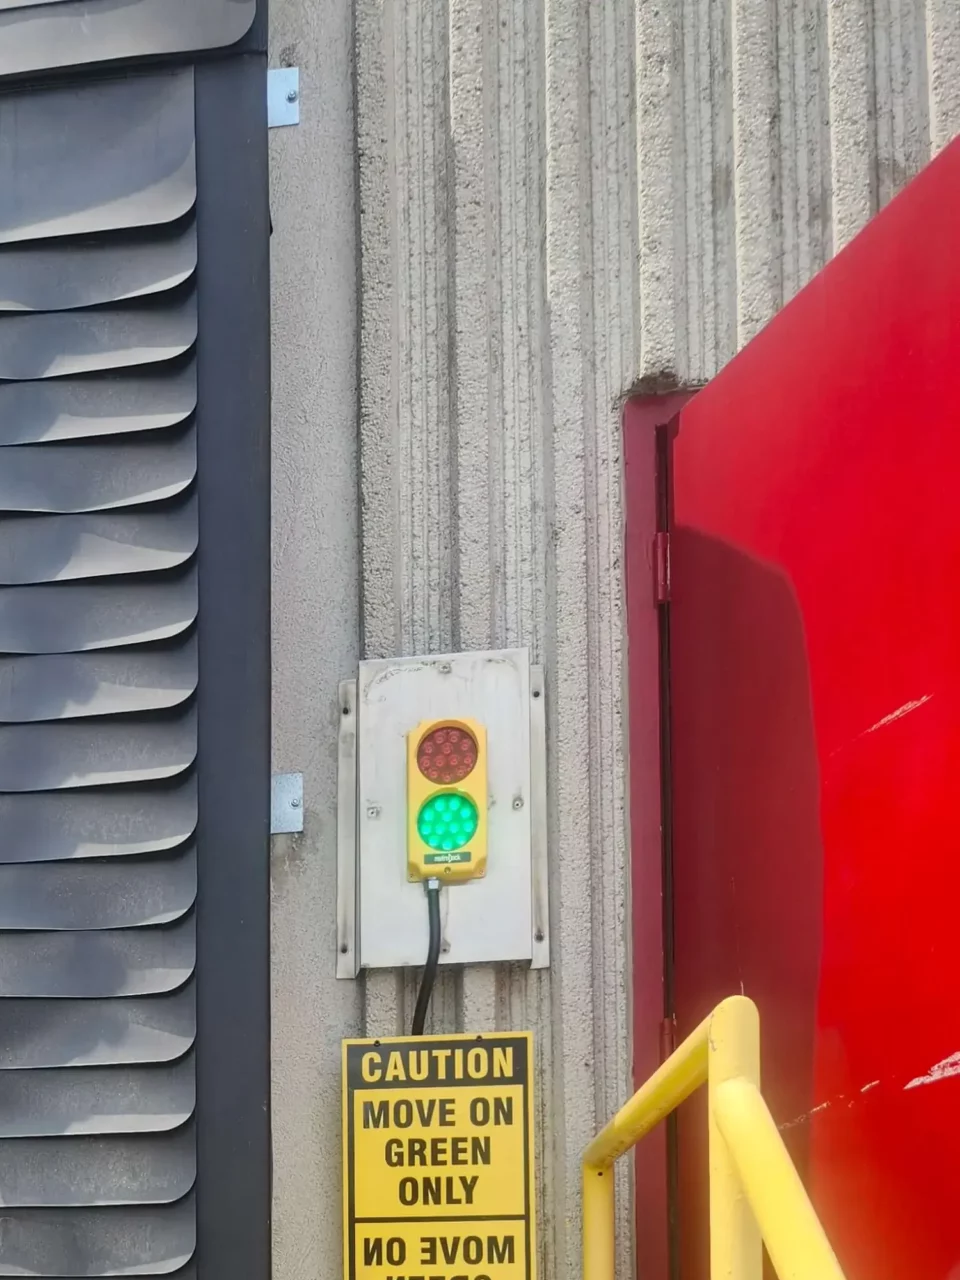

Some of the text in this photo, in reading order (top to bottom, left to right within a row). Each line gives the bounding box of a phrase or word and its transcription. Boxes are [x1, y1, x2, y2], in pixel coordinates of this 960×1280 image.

[361, 1047, 514, 1083] CAUTION
[362, 1096, 513, 1129] MOVE ON
[385, 1136, 491, 1167] GREEN
[398, 1175, 479, 1206] ONLY
